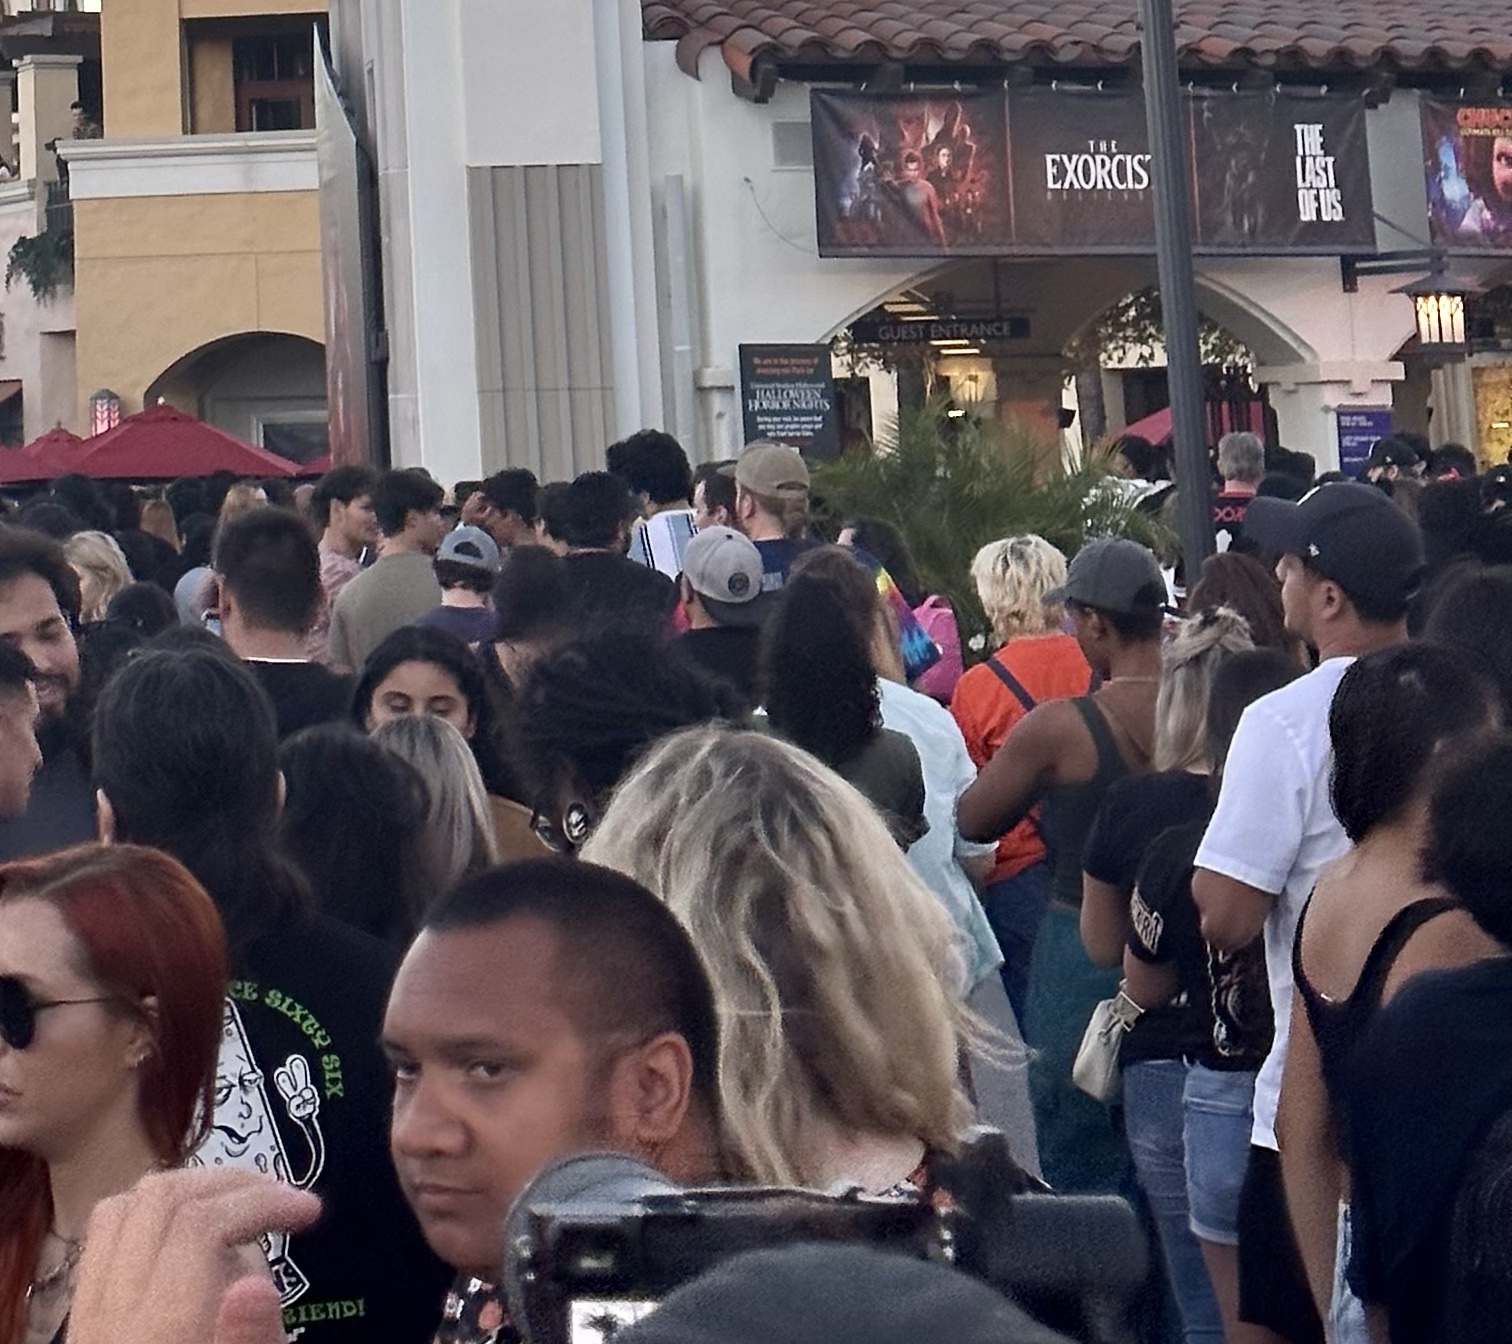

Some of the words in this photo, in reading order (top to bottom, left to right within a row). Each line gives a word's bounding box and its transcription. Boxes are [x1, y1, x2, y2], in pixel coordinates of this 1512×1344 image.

[1088, 139, 1117, 153] THE
[1294, 123, 1324, 156] THE
[1044, 154, 1152, 190] EXORCIS
[1295, 156, 1336, 189] LAST
[1298, 188, 1319, 222] OF
[1319, 188, 1345, 222] US
[878, 325, 925, 340] GUEST
[930, 322, 1011, 338] ENTRANCE
[756, 388, 822, 400] HALLOWEEN
[322, 1054, 345, 1099] SIX
[283, 1297, 366, 1325] RIEND!
